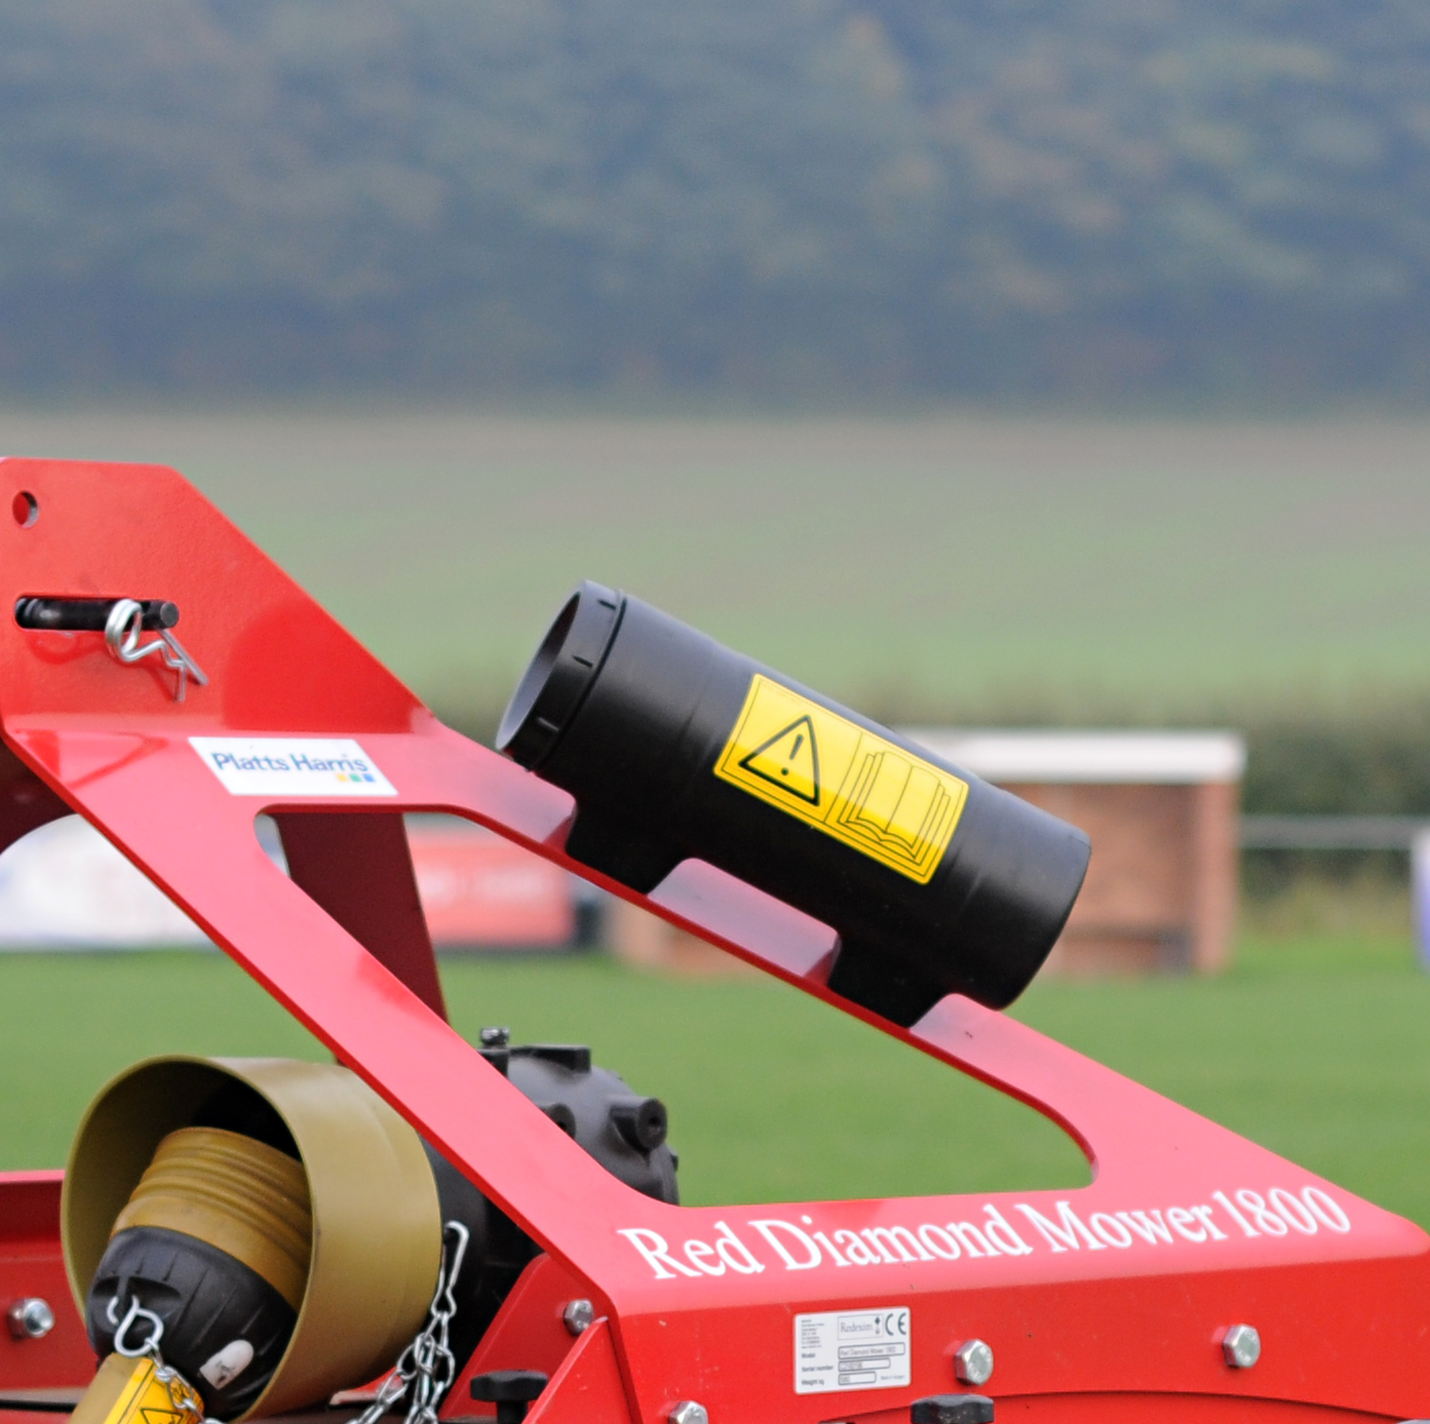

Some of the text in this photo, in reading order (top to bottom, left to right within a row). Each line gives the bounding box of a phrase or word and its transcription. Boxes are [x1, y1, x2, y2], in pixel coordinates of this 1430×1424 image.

[211, 752, 369, 772] Platts Harris
[617, 1186, 1351, 1279] Red Diamond Mower 1800
